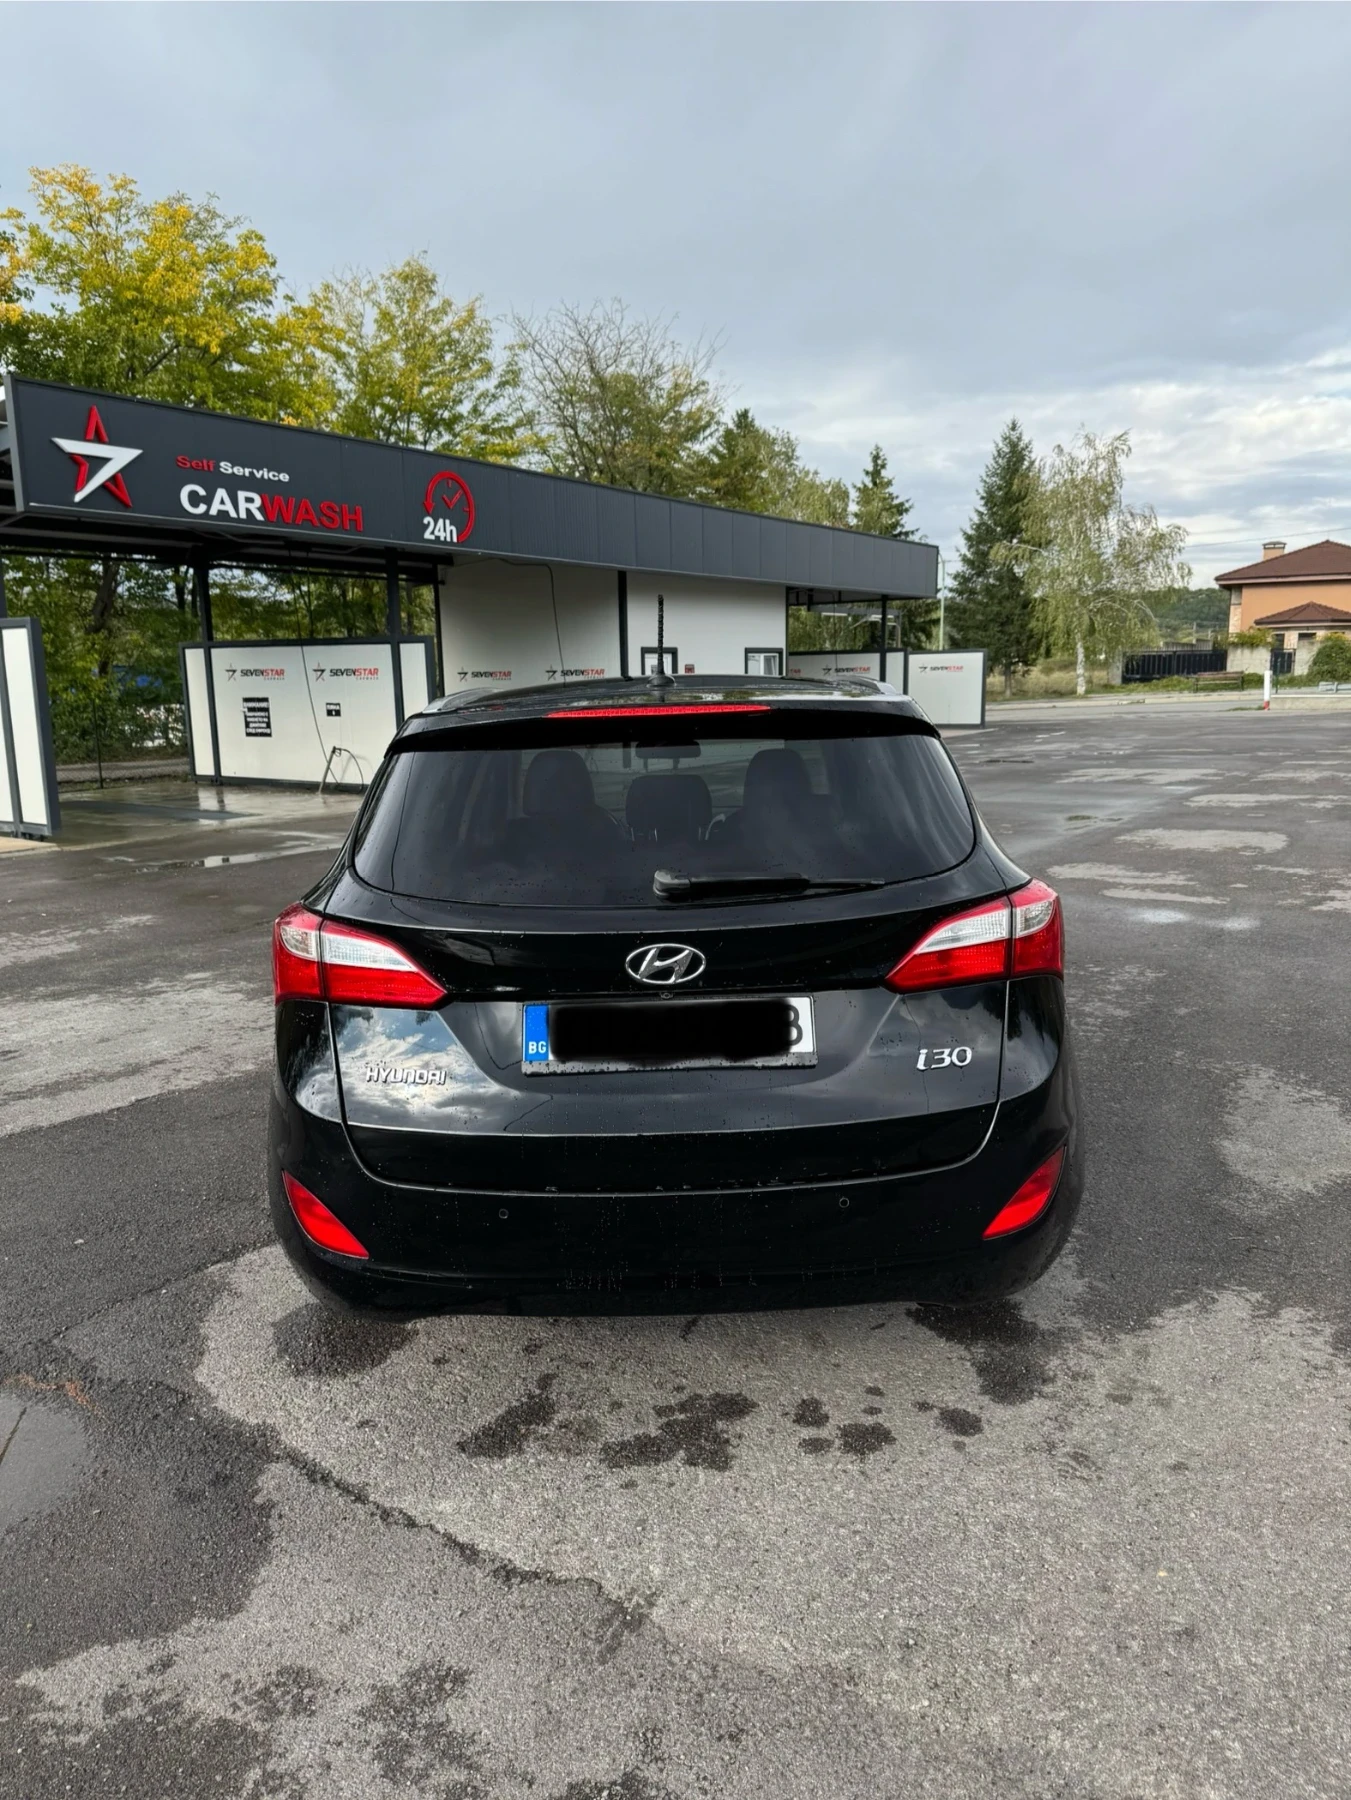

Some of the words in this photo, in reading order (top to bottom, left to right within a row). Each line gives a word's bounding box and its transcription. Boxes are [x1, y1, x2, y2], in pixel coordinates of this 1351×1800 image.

[176, 455, 216, 472] Self
[219, 461, 290, 482] Service
[180, 483, 363, 532] CARWASH
[423, 516, 457, 543] 24h
[240, 668, 285, 677] SEVENSTAR
[329, 667, 379, 677] SEVENSTAR
[528, 1041, 547, 1054] BG
[916, 1046, 972, 1071] i30
[366, 1067, 447, 1086] HYUNDAI
